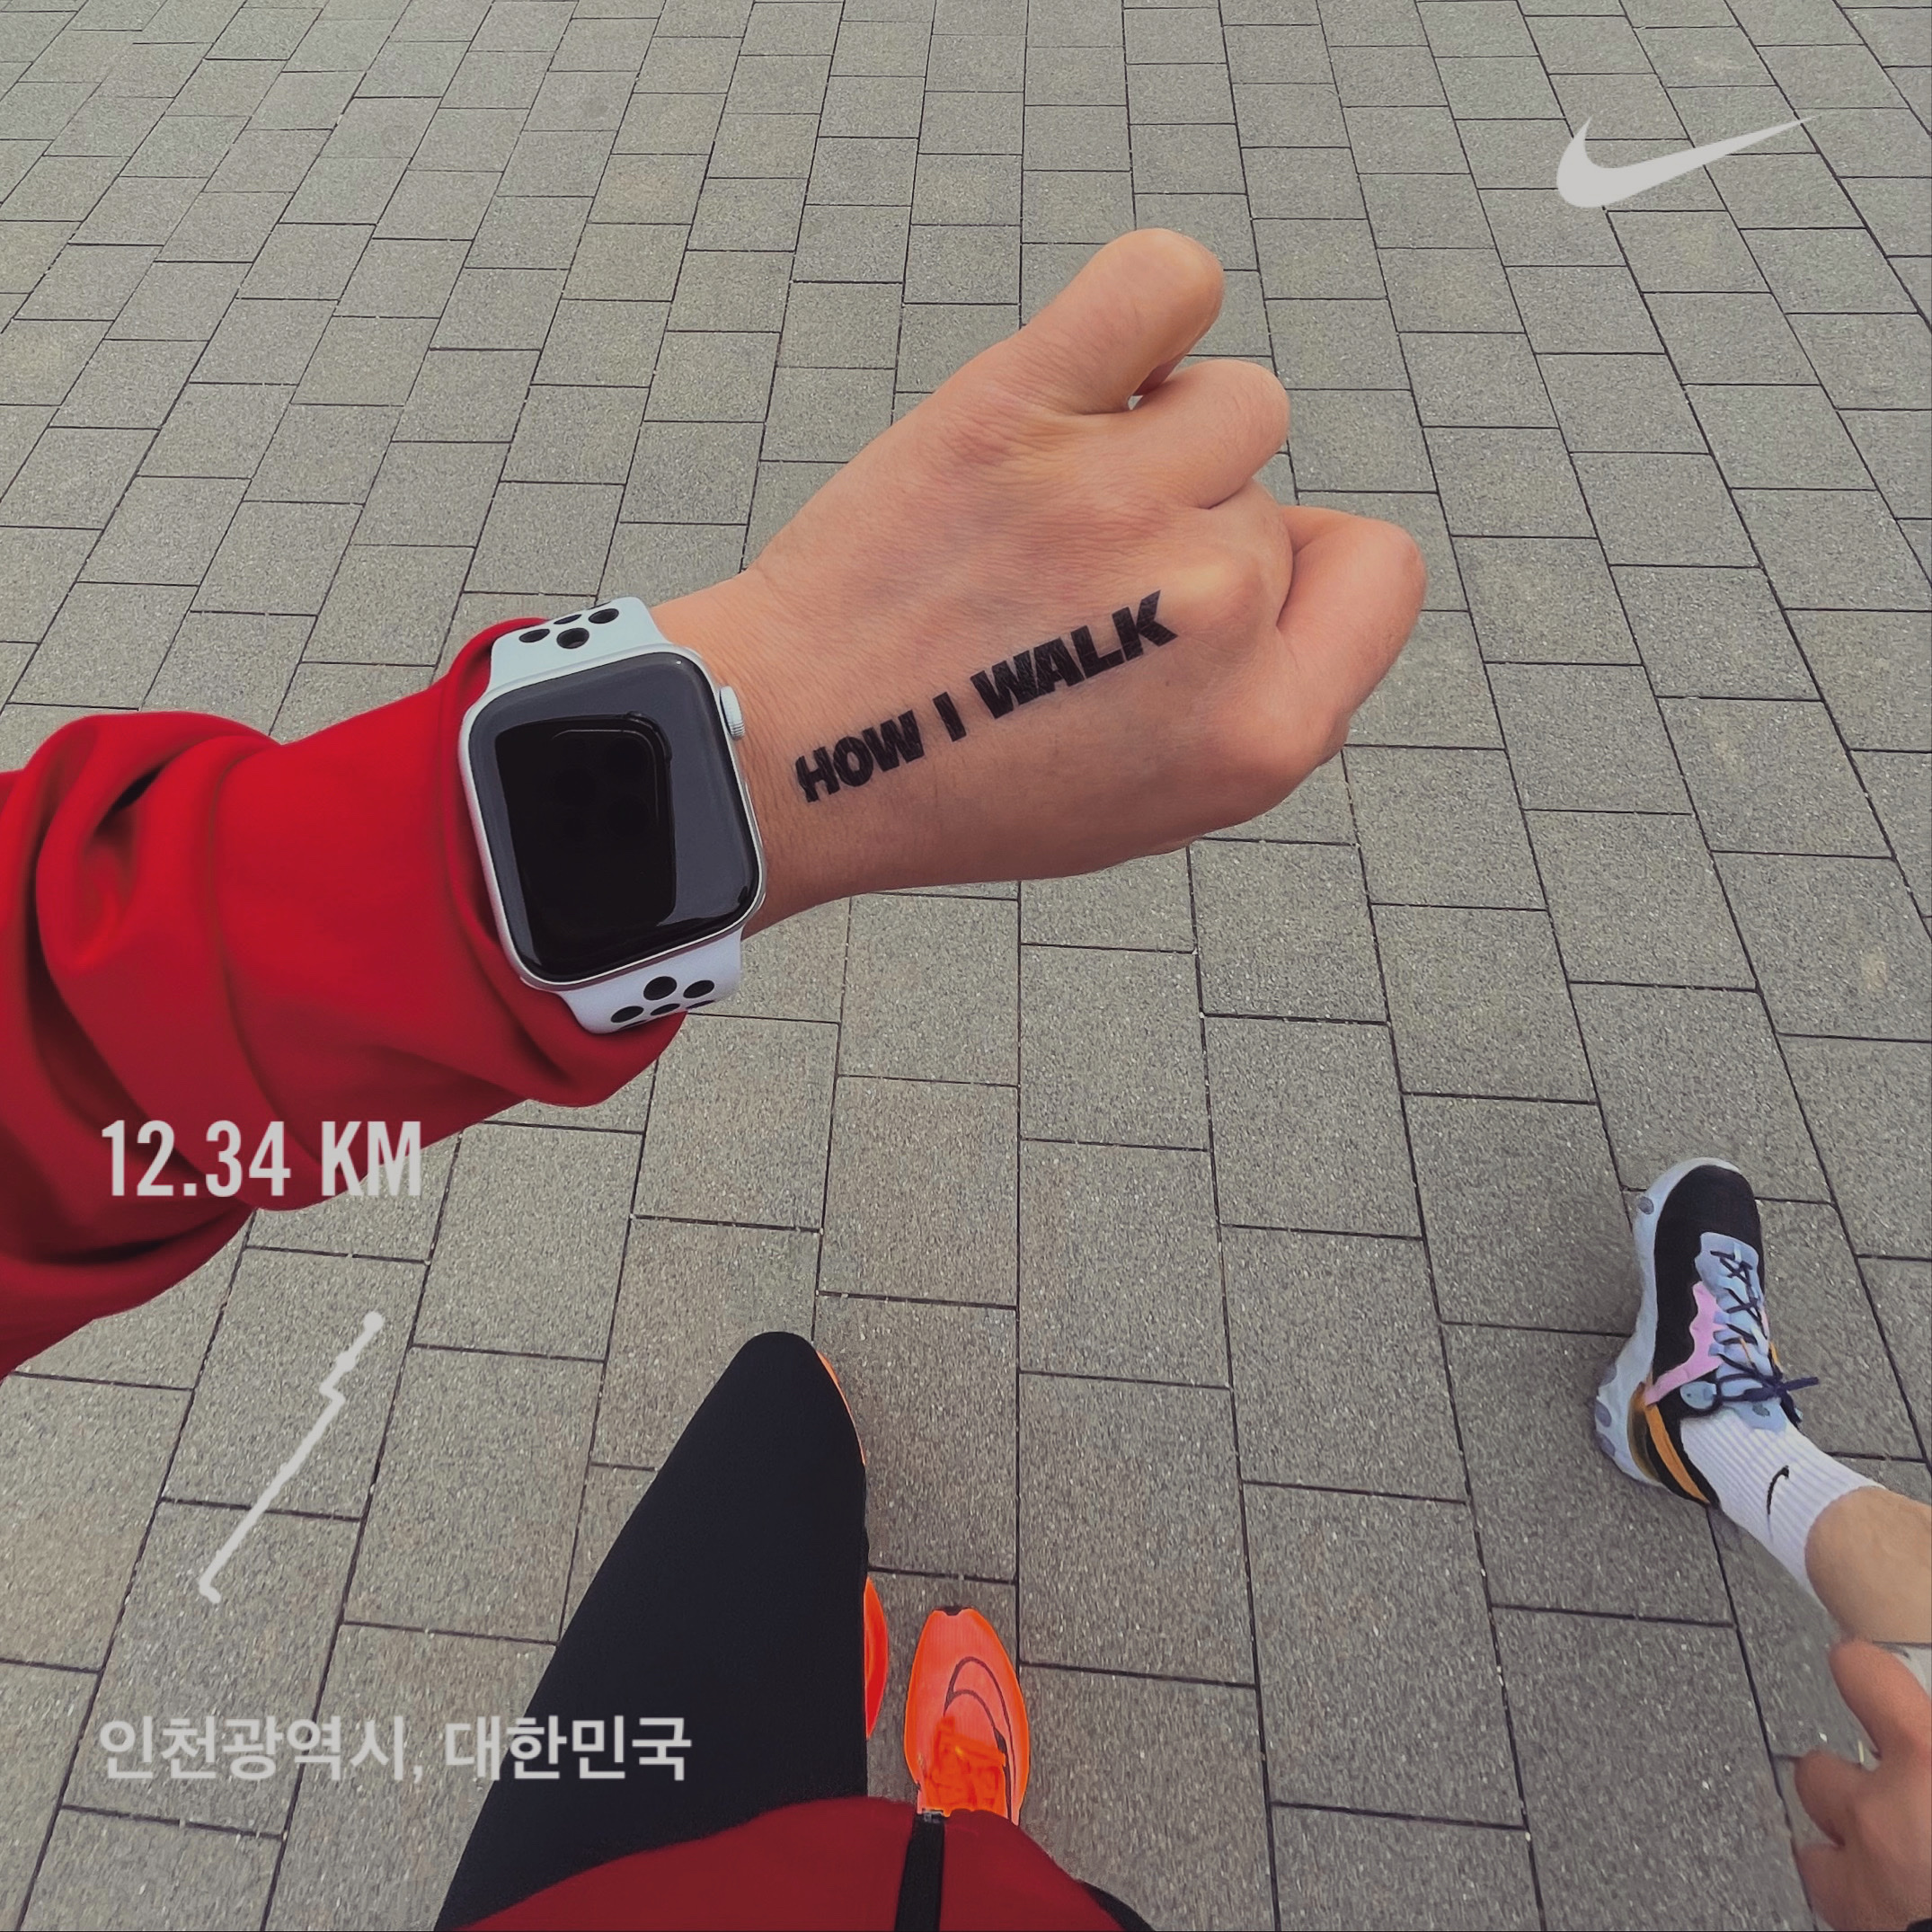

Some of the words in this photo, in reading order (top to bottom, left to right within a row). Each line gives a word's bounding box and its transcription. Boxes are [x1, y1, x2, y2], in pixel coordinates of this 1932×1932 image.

[794, 709, 925, 802] HOW
[932, 691, 967, 742] I
[970, 589, 1179, 719] WALK
